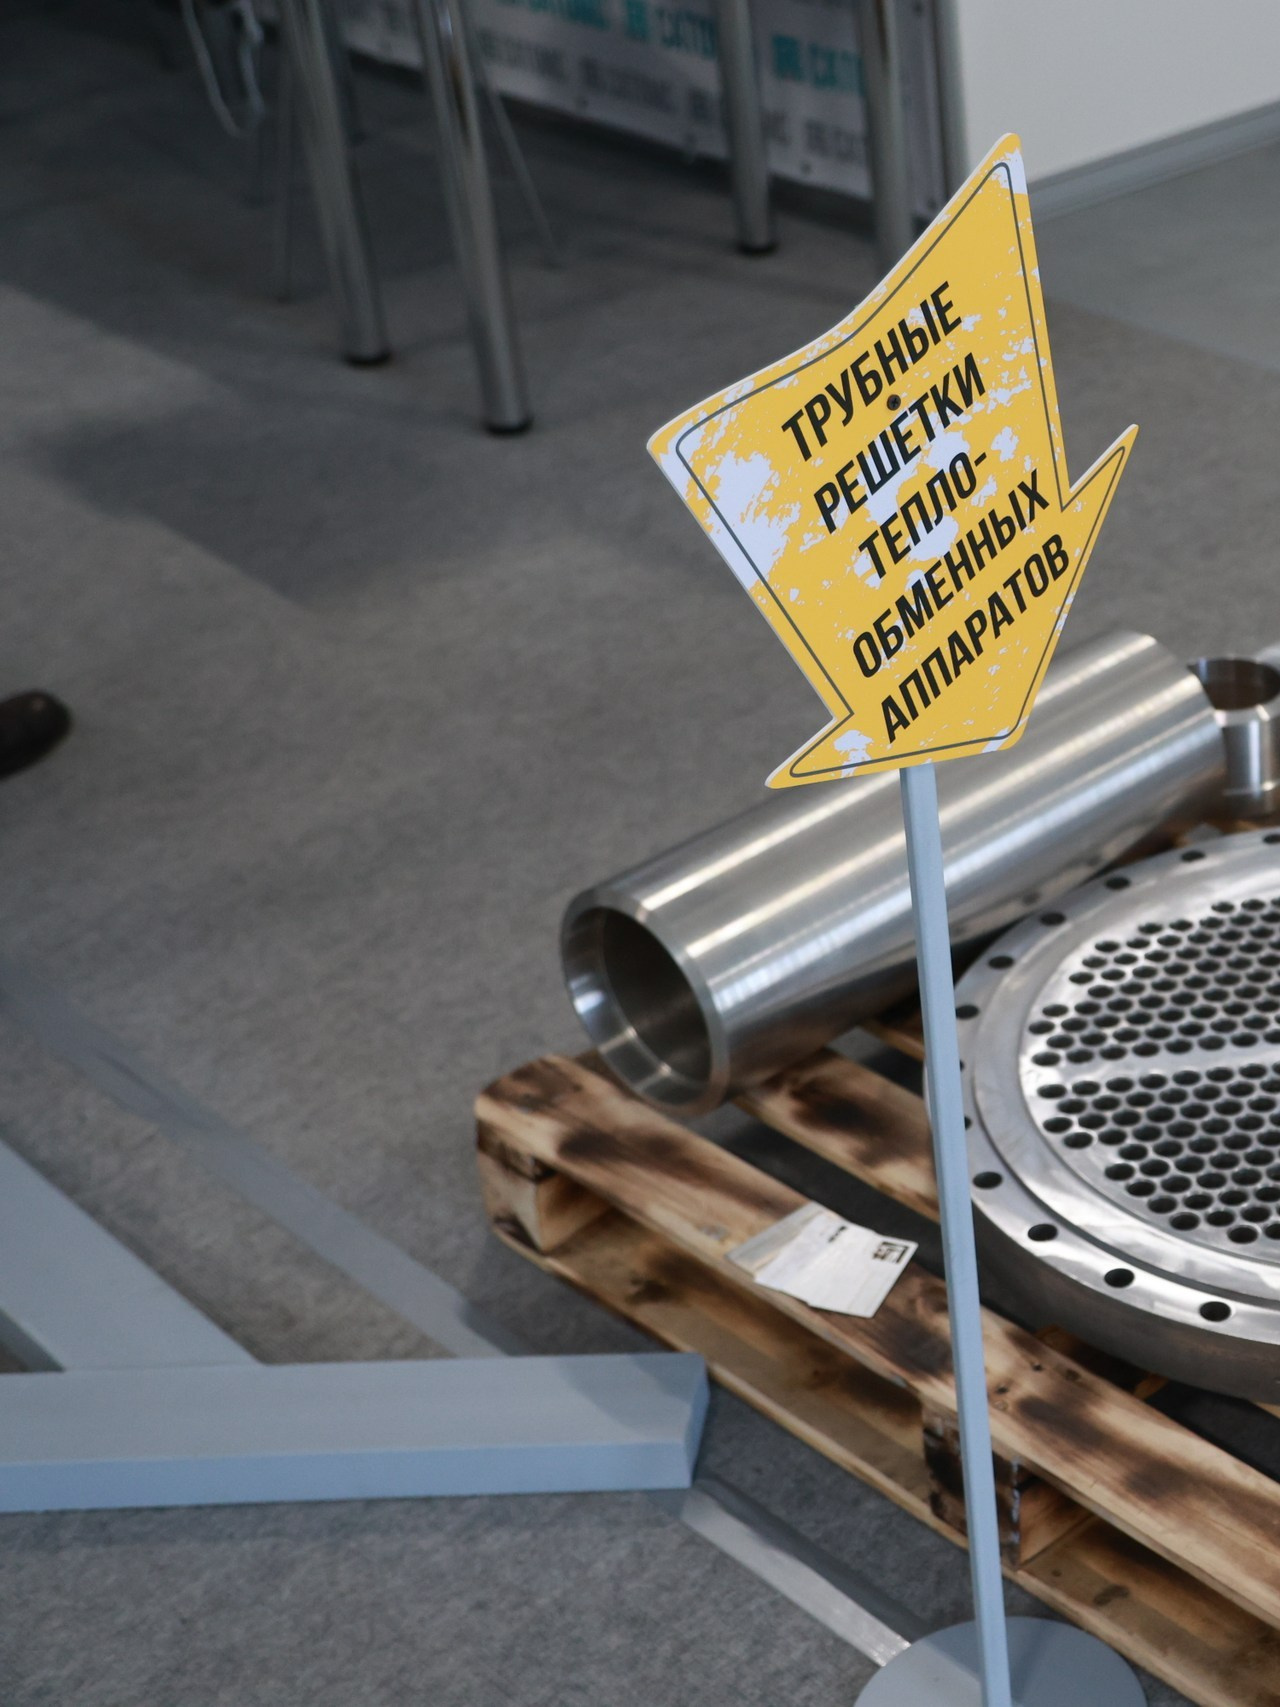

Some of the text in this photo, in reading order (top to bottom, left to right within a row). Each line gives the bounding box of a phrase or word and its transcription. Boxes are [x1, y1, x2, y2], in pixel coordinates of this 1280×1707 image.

[781, 280, 962, 462] ТРУБНЫЕ
[813, 352, 986, 534] РЕШЕТКИ
[853, 468, 1050, 679] ОБМЕННЫХ
[858, 452, 987, 579] ТЕПЛО-
[880, 534, 1069, 744] АППАРАТОВ
